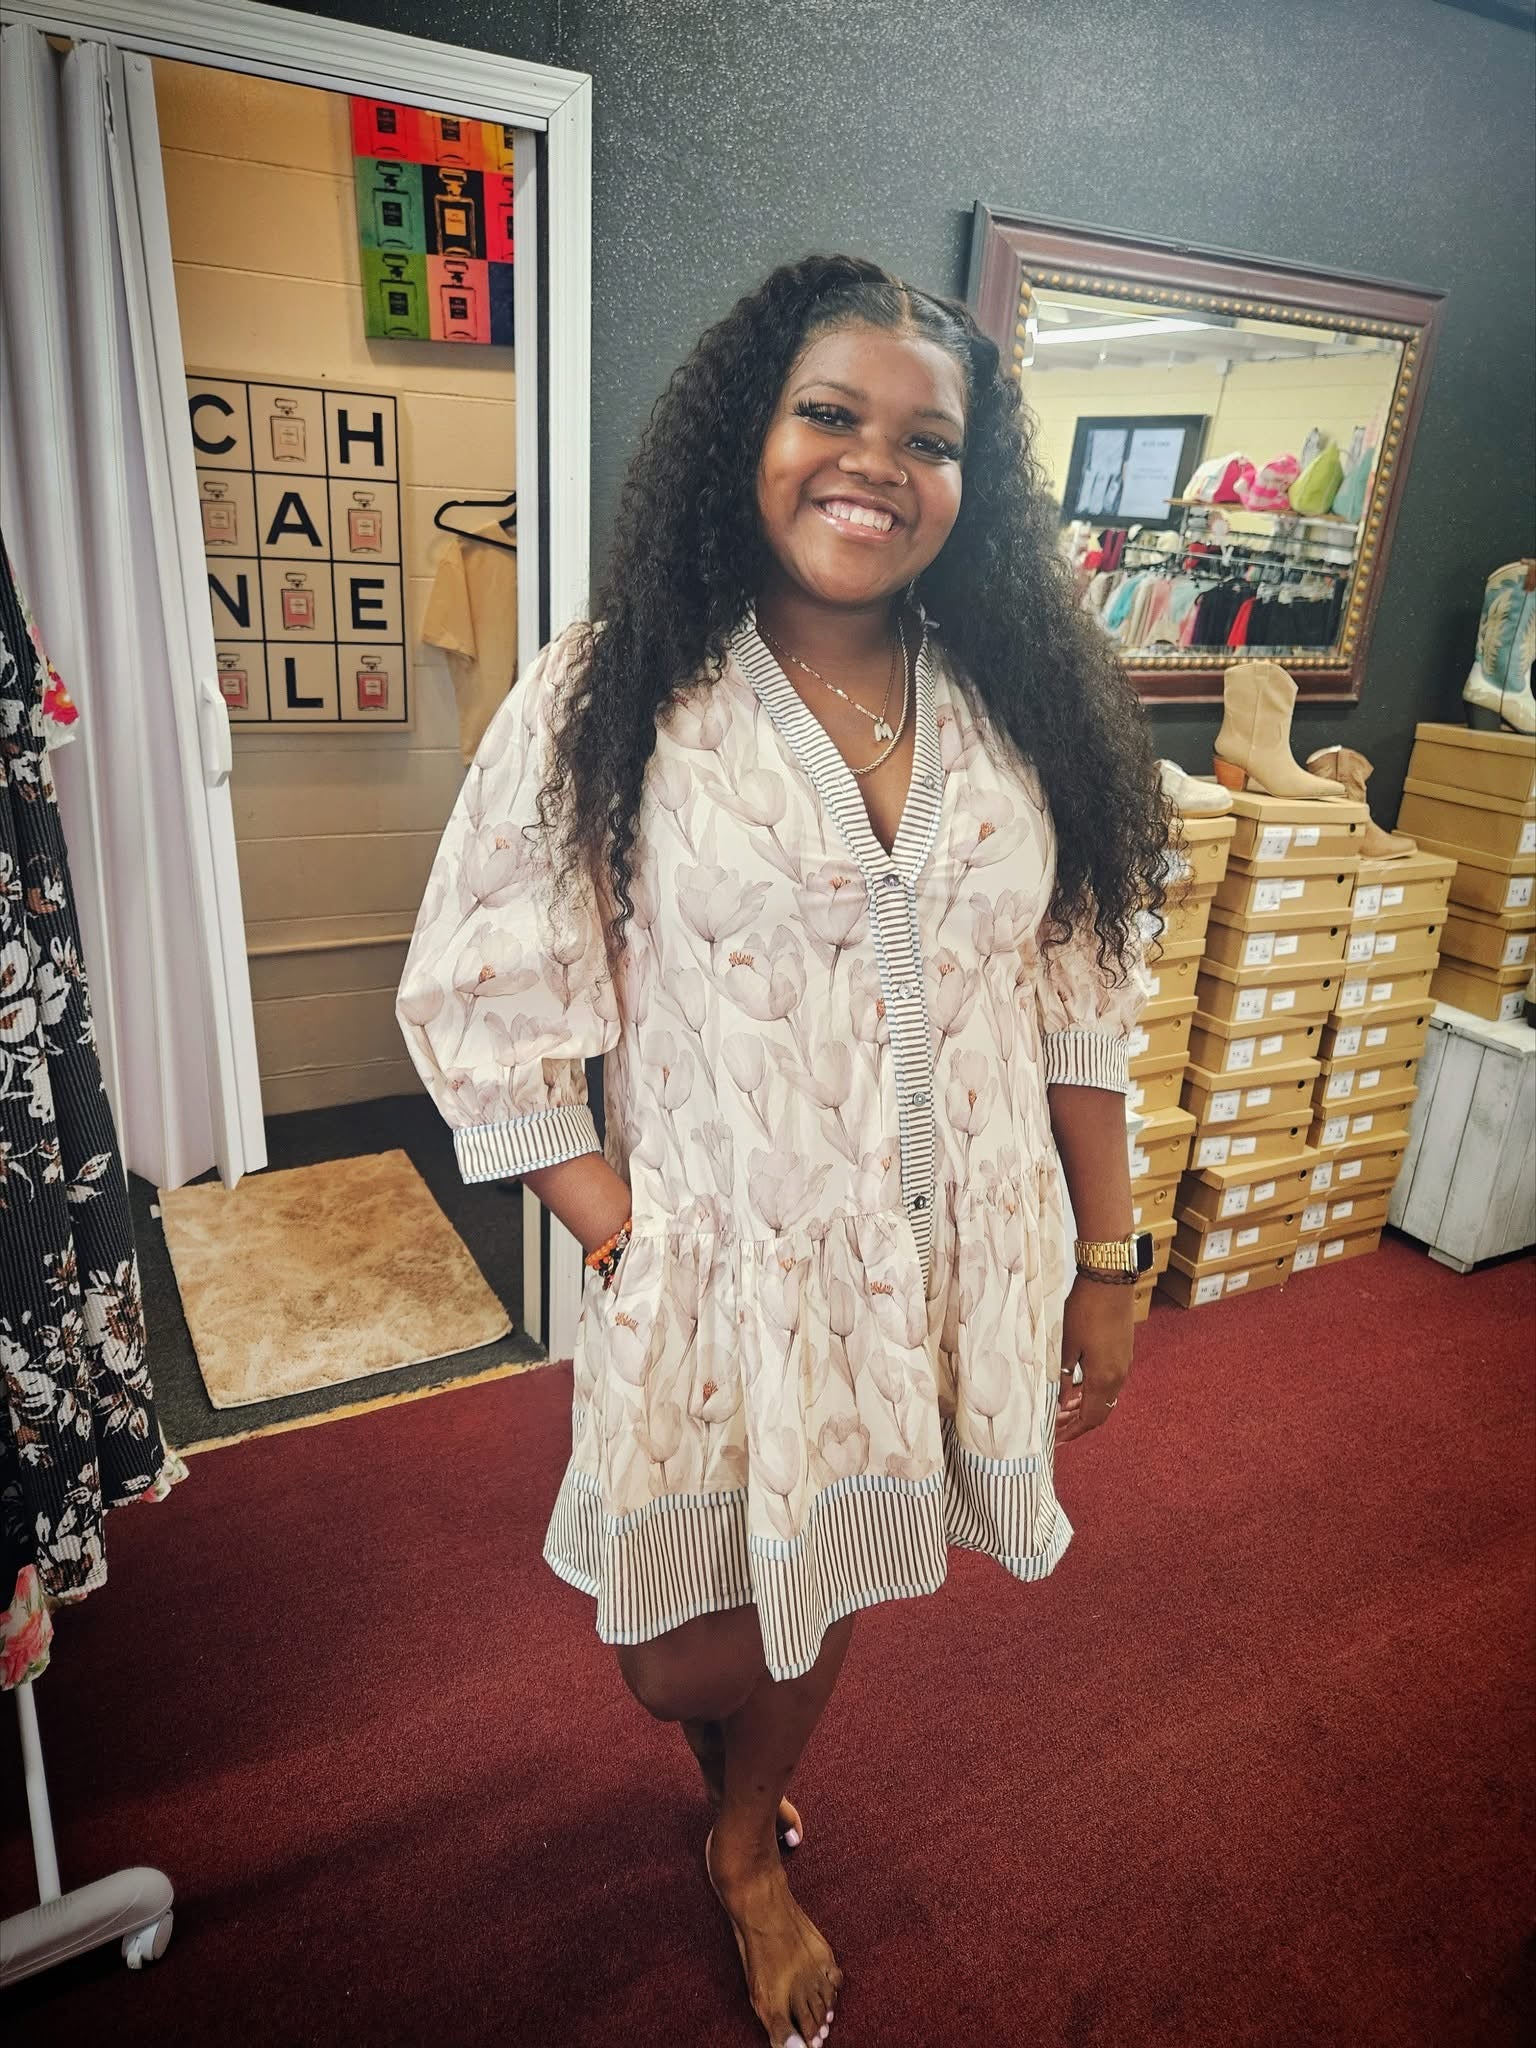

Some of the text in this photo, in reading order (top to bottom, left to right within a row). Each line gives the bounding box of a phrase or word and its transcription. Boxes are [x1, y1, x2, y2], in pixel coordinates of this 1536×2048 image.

[188, 393, 384, 466] C H
[265, 492, 323, 547] A
[208, 573, 387, 630] N E
[284, 658, 323, 708] L
